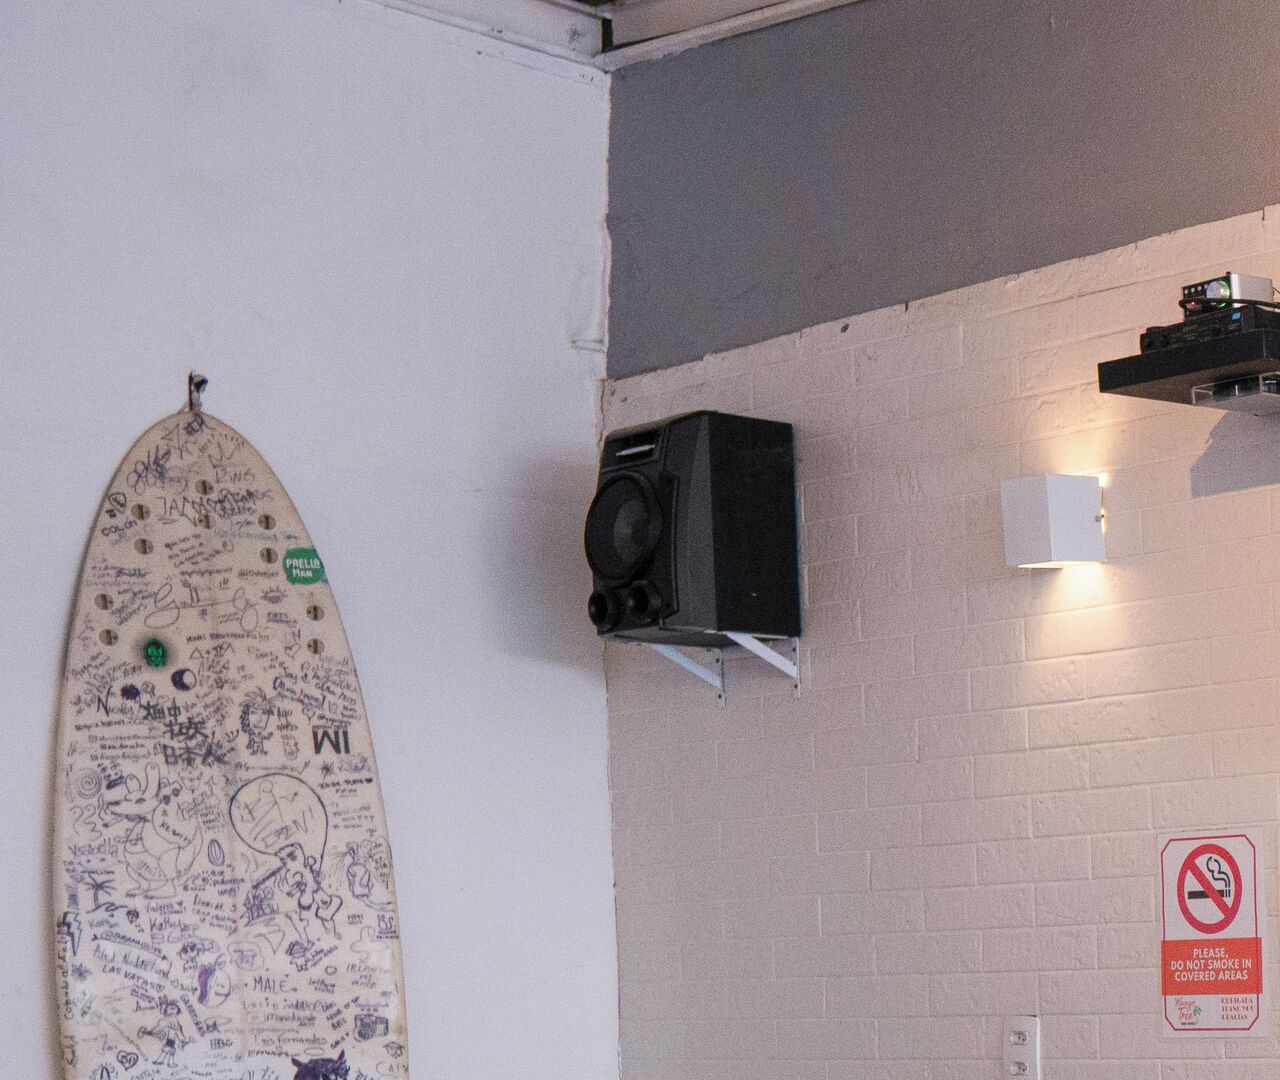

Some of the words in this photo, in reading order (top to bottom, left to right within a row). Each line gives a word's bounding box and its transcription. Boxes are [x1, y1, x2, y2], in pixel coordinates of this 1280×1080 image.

[1193, 948, 1229, 958] PLEASE,
[1171, 961, 1185, 970] DO
[1186, 960, 1207, 970] NOT
[1208, 959, 1240, 969] SMOKE
[1242, 959, 1252, 968] IN
[1175, 971, 1216, 981] COVERED
[1217, 970, 1248, 980] AREAS
